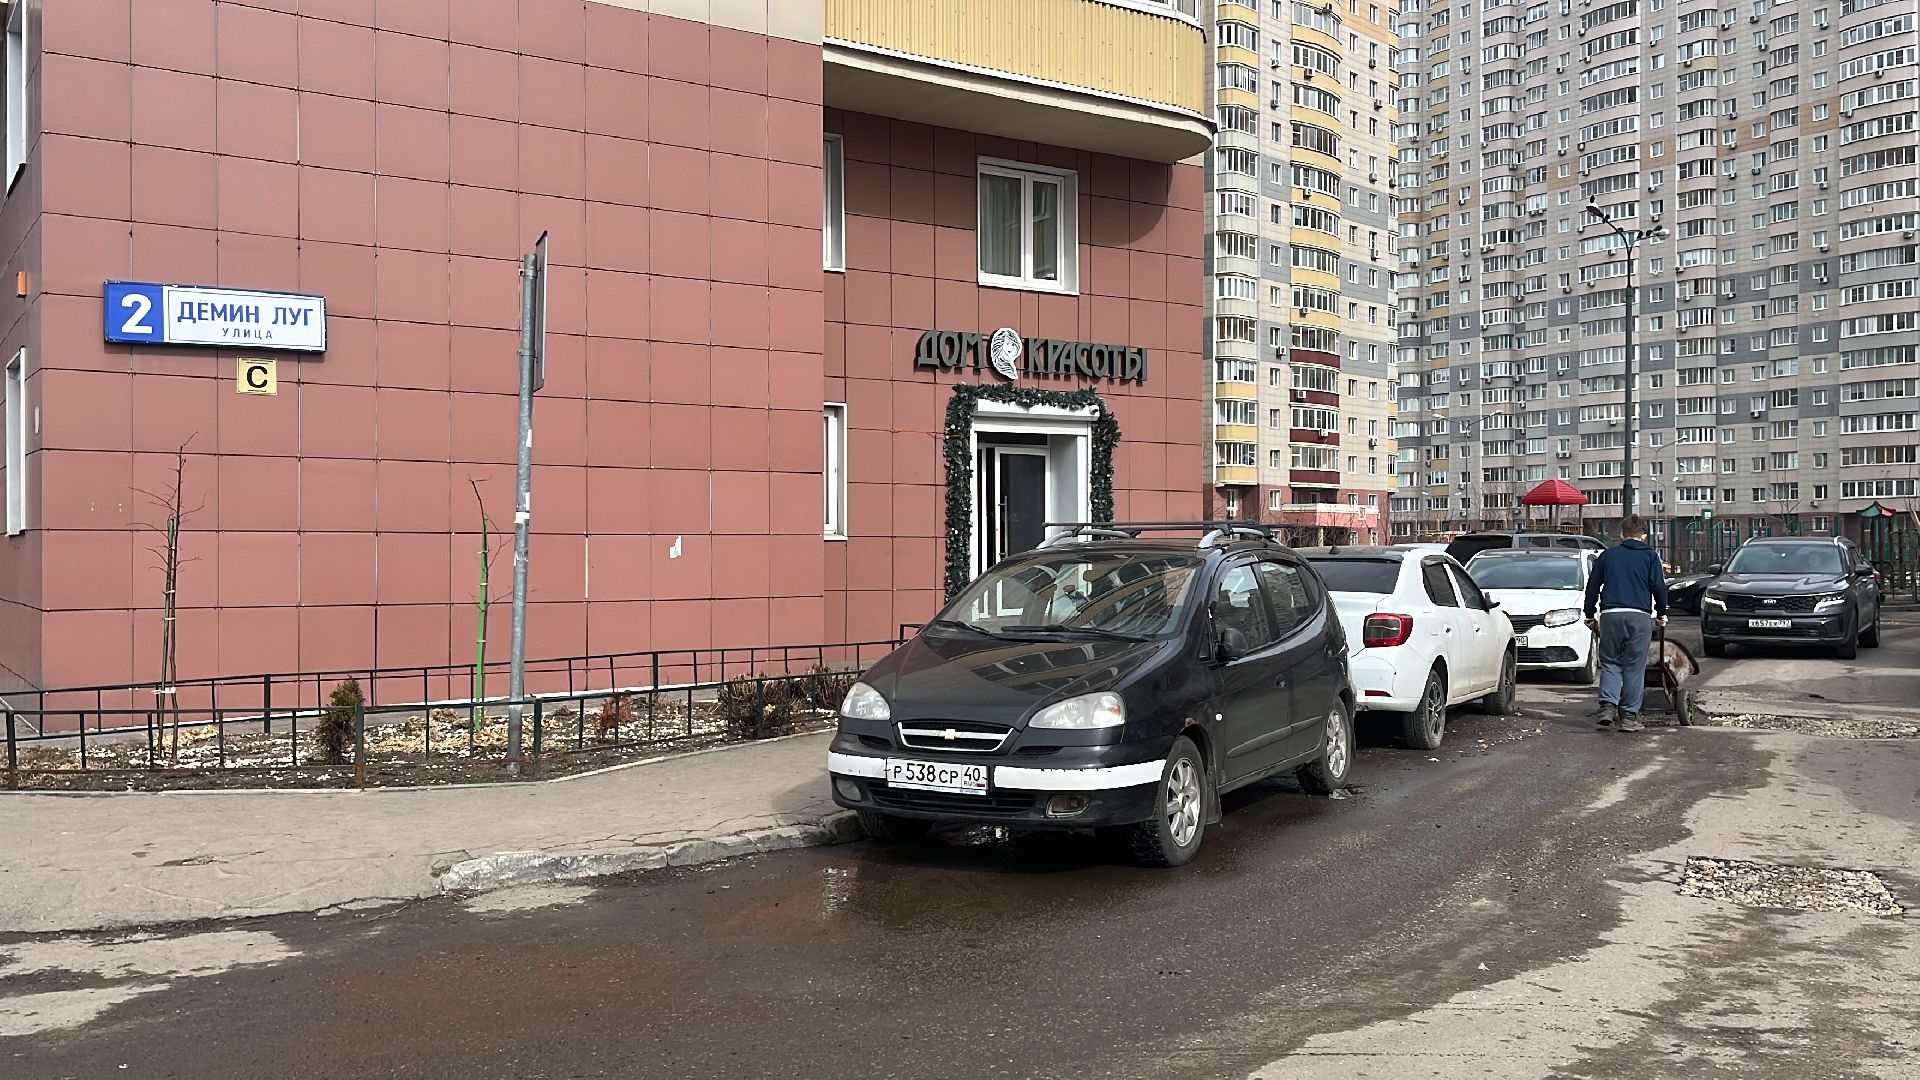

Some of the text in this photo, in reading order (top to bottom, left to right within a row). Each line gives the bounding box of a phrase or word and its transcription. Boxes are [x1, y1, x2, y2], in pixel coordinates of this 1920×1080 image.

[121, 293, 153, 334] 2
[271, 307, 314, 326] ЛУГ
[222, 328, 273, 339] УЛИЦА
[917, 329, 1148, 381] ДОМ КРАСОТЫ
[963, 766, 981, 781] 40
